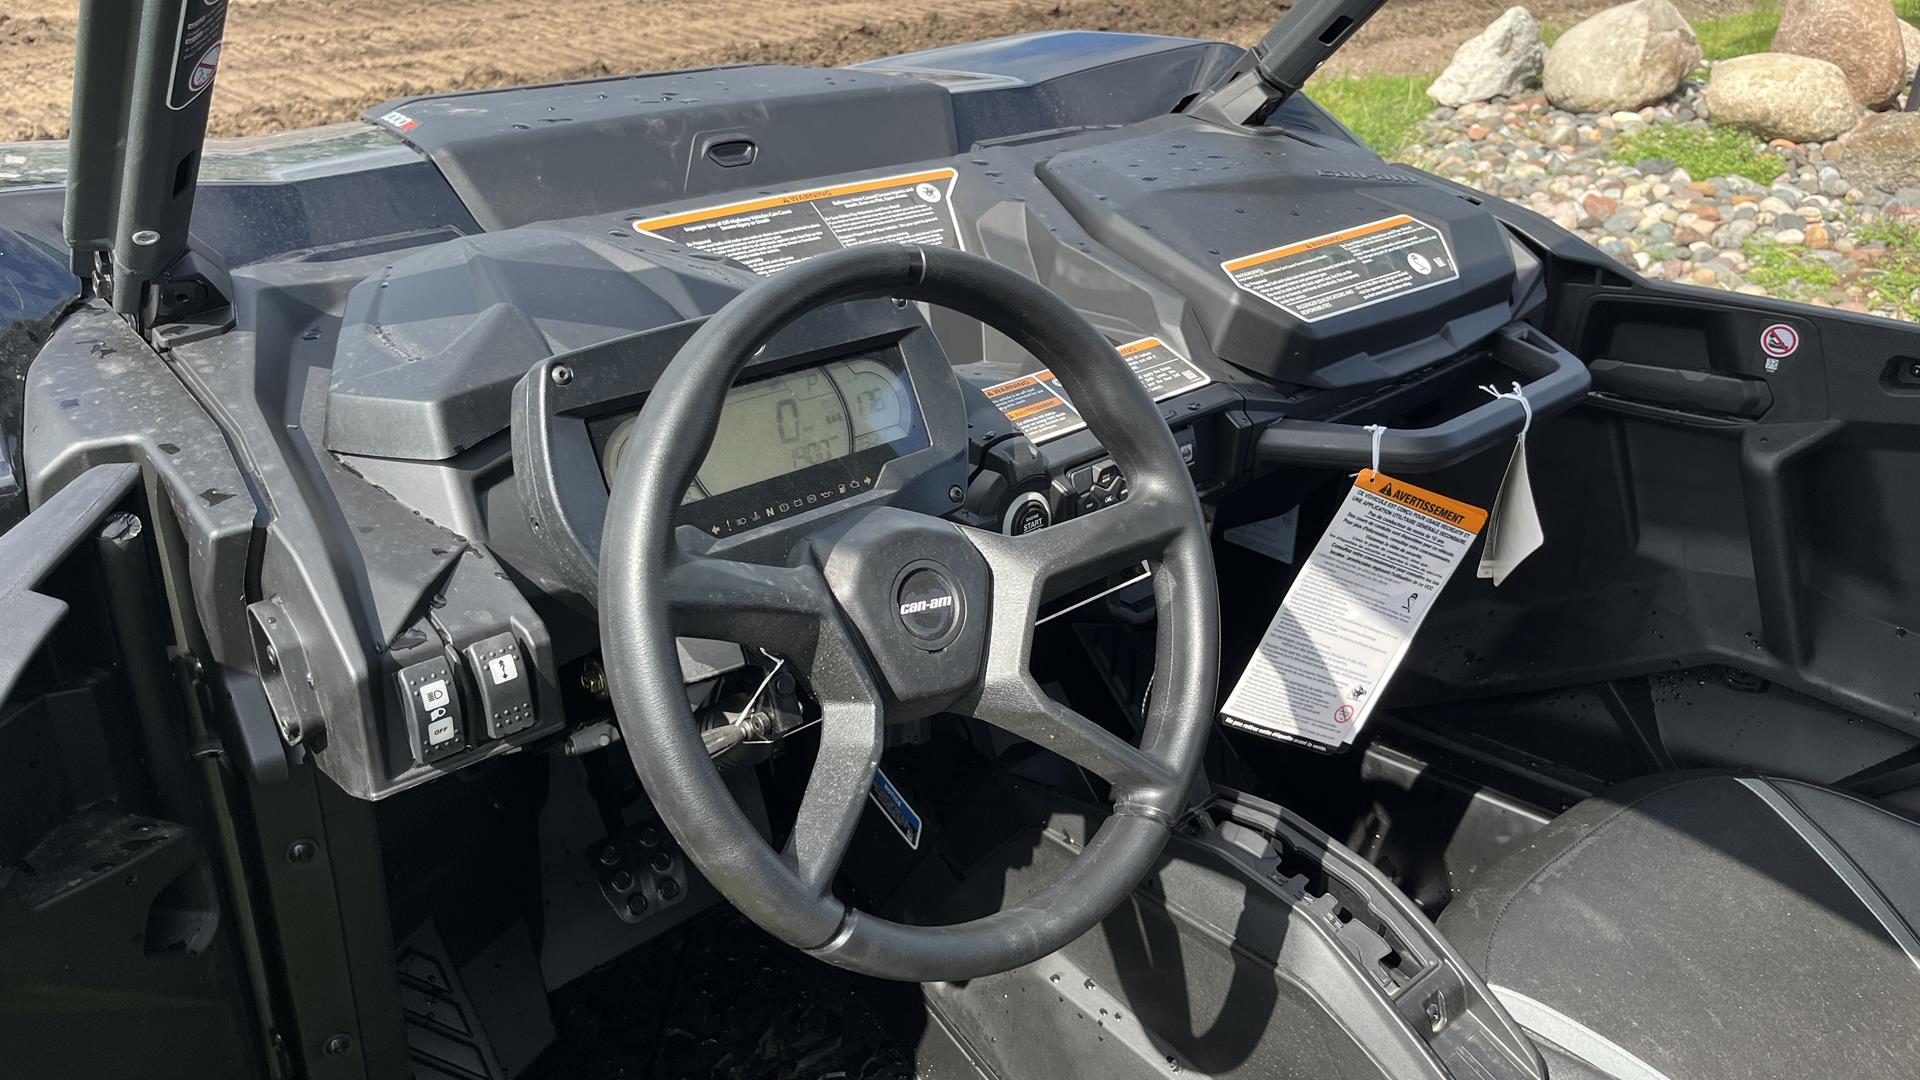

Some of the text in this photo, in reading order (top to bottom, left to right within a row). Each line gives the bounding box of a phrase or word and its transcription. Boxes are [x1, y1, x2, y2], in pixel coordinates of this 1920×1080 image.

[790, 190, 832, 203] WARNING
[992, 380, 1030, 394] WARNING
[776, 398, 800, 444] 0
[766, 508, 775, 518] N
[1363, 501, 1392, 515] APPLICATION
[1392, 513, 1416, 525] UTILITAIRE
[1392, 490, 1465, 524] AVERTISSEMENT
[1024, 518, 1043, 531] START
[1383, 518, 1406, 528] conducteur
[1426, 519, 1441, 527] USAGE
[1332, 543, 1353, 553] Consultez
[1364, 556, 1396, 569] concessionnaire
[900, 596, 952, 614] can-am
[434, 726, 448, 736] OFF
